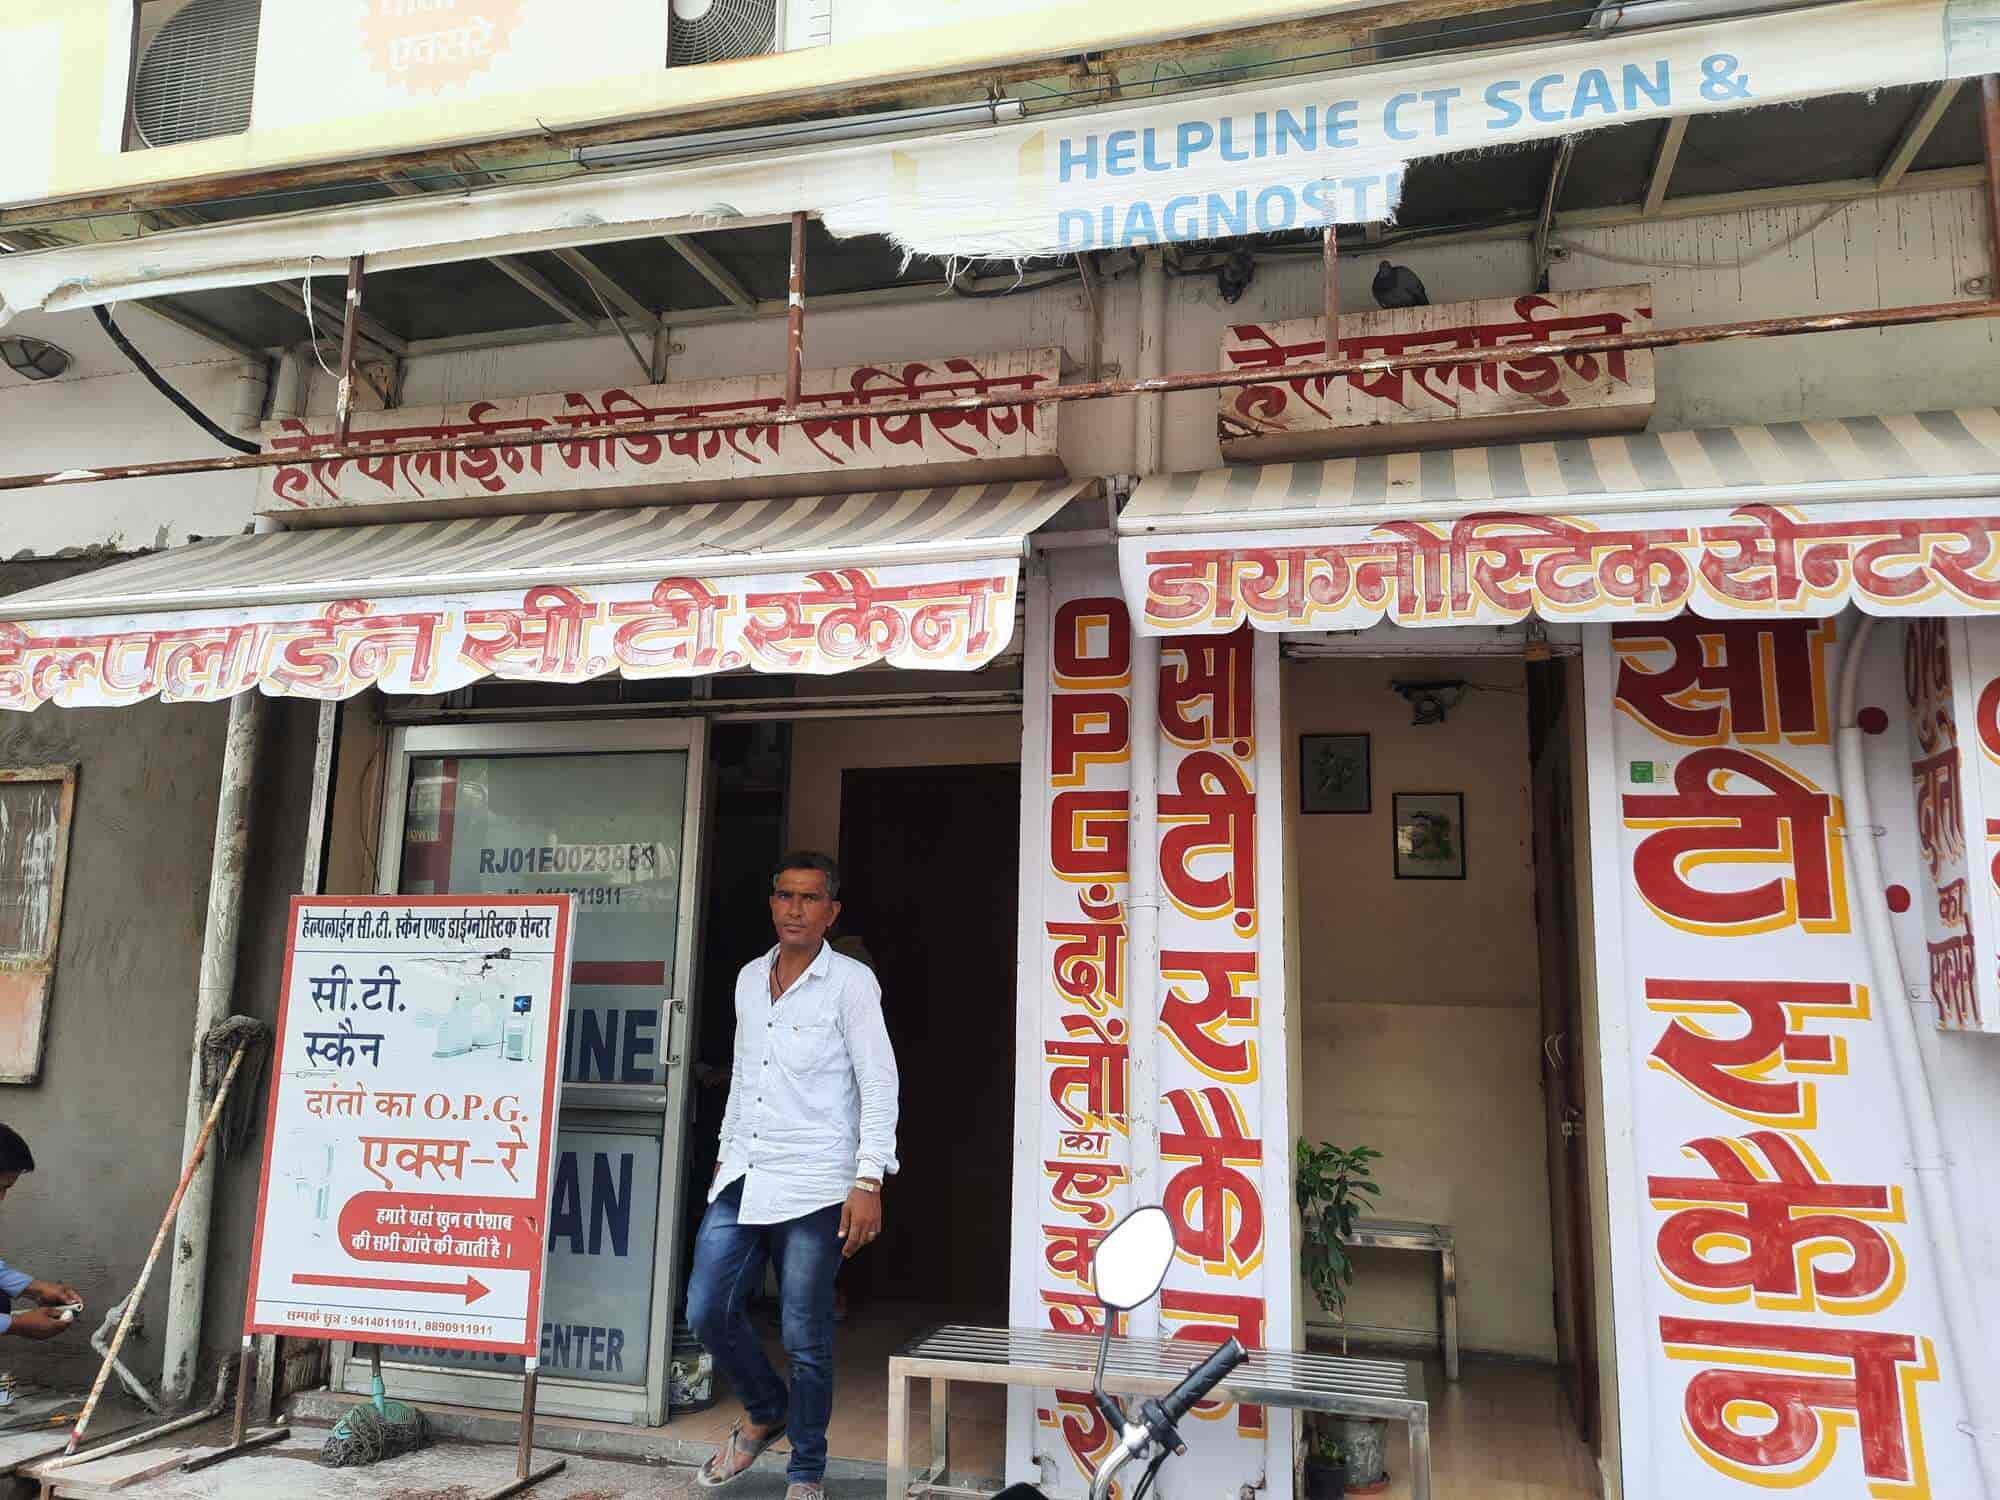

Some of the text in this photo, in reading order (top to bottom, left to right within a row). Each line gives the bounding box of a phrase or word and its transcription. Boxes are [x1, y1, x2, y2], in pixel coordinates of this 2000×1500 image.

[1059, 53, 1753, 183] HELPLINE CT SCAN &
[396, 909, 421, 939] स्कैन
[309, 964, 406, 1013] सी.टी.
[303, 1017, 385, 1069] स्कैन
[374, 1091, 417, 1118] का
[424, 1092, 529, 1123] O.P.G.
[1058, 1129, 1111, 1166] का
[376, 1204, 409, 1225] हमारे
[352, 1229, 371, 1250] की
[434, 1233, 455, 1256] की
[541, 1322, 625, 1373] ENTER
